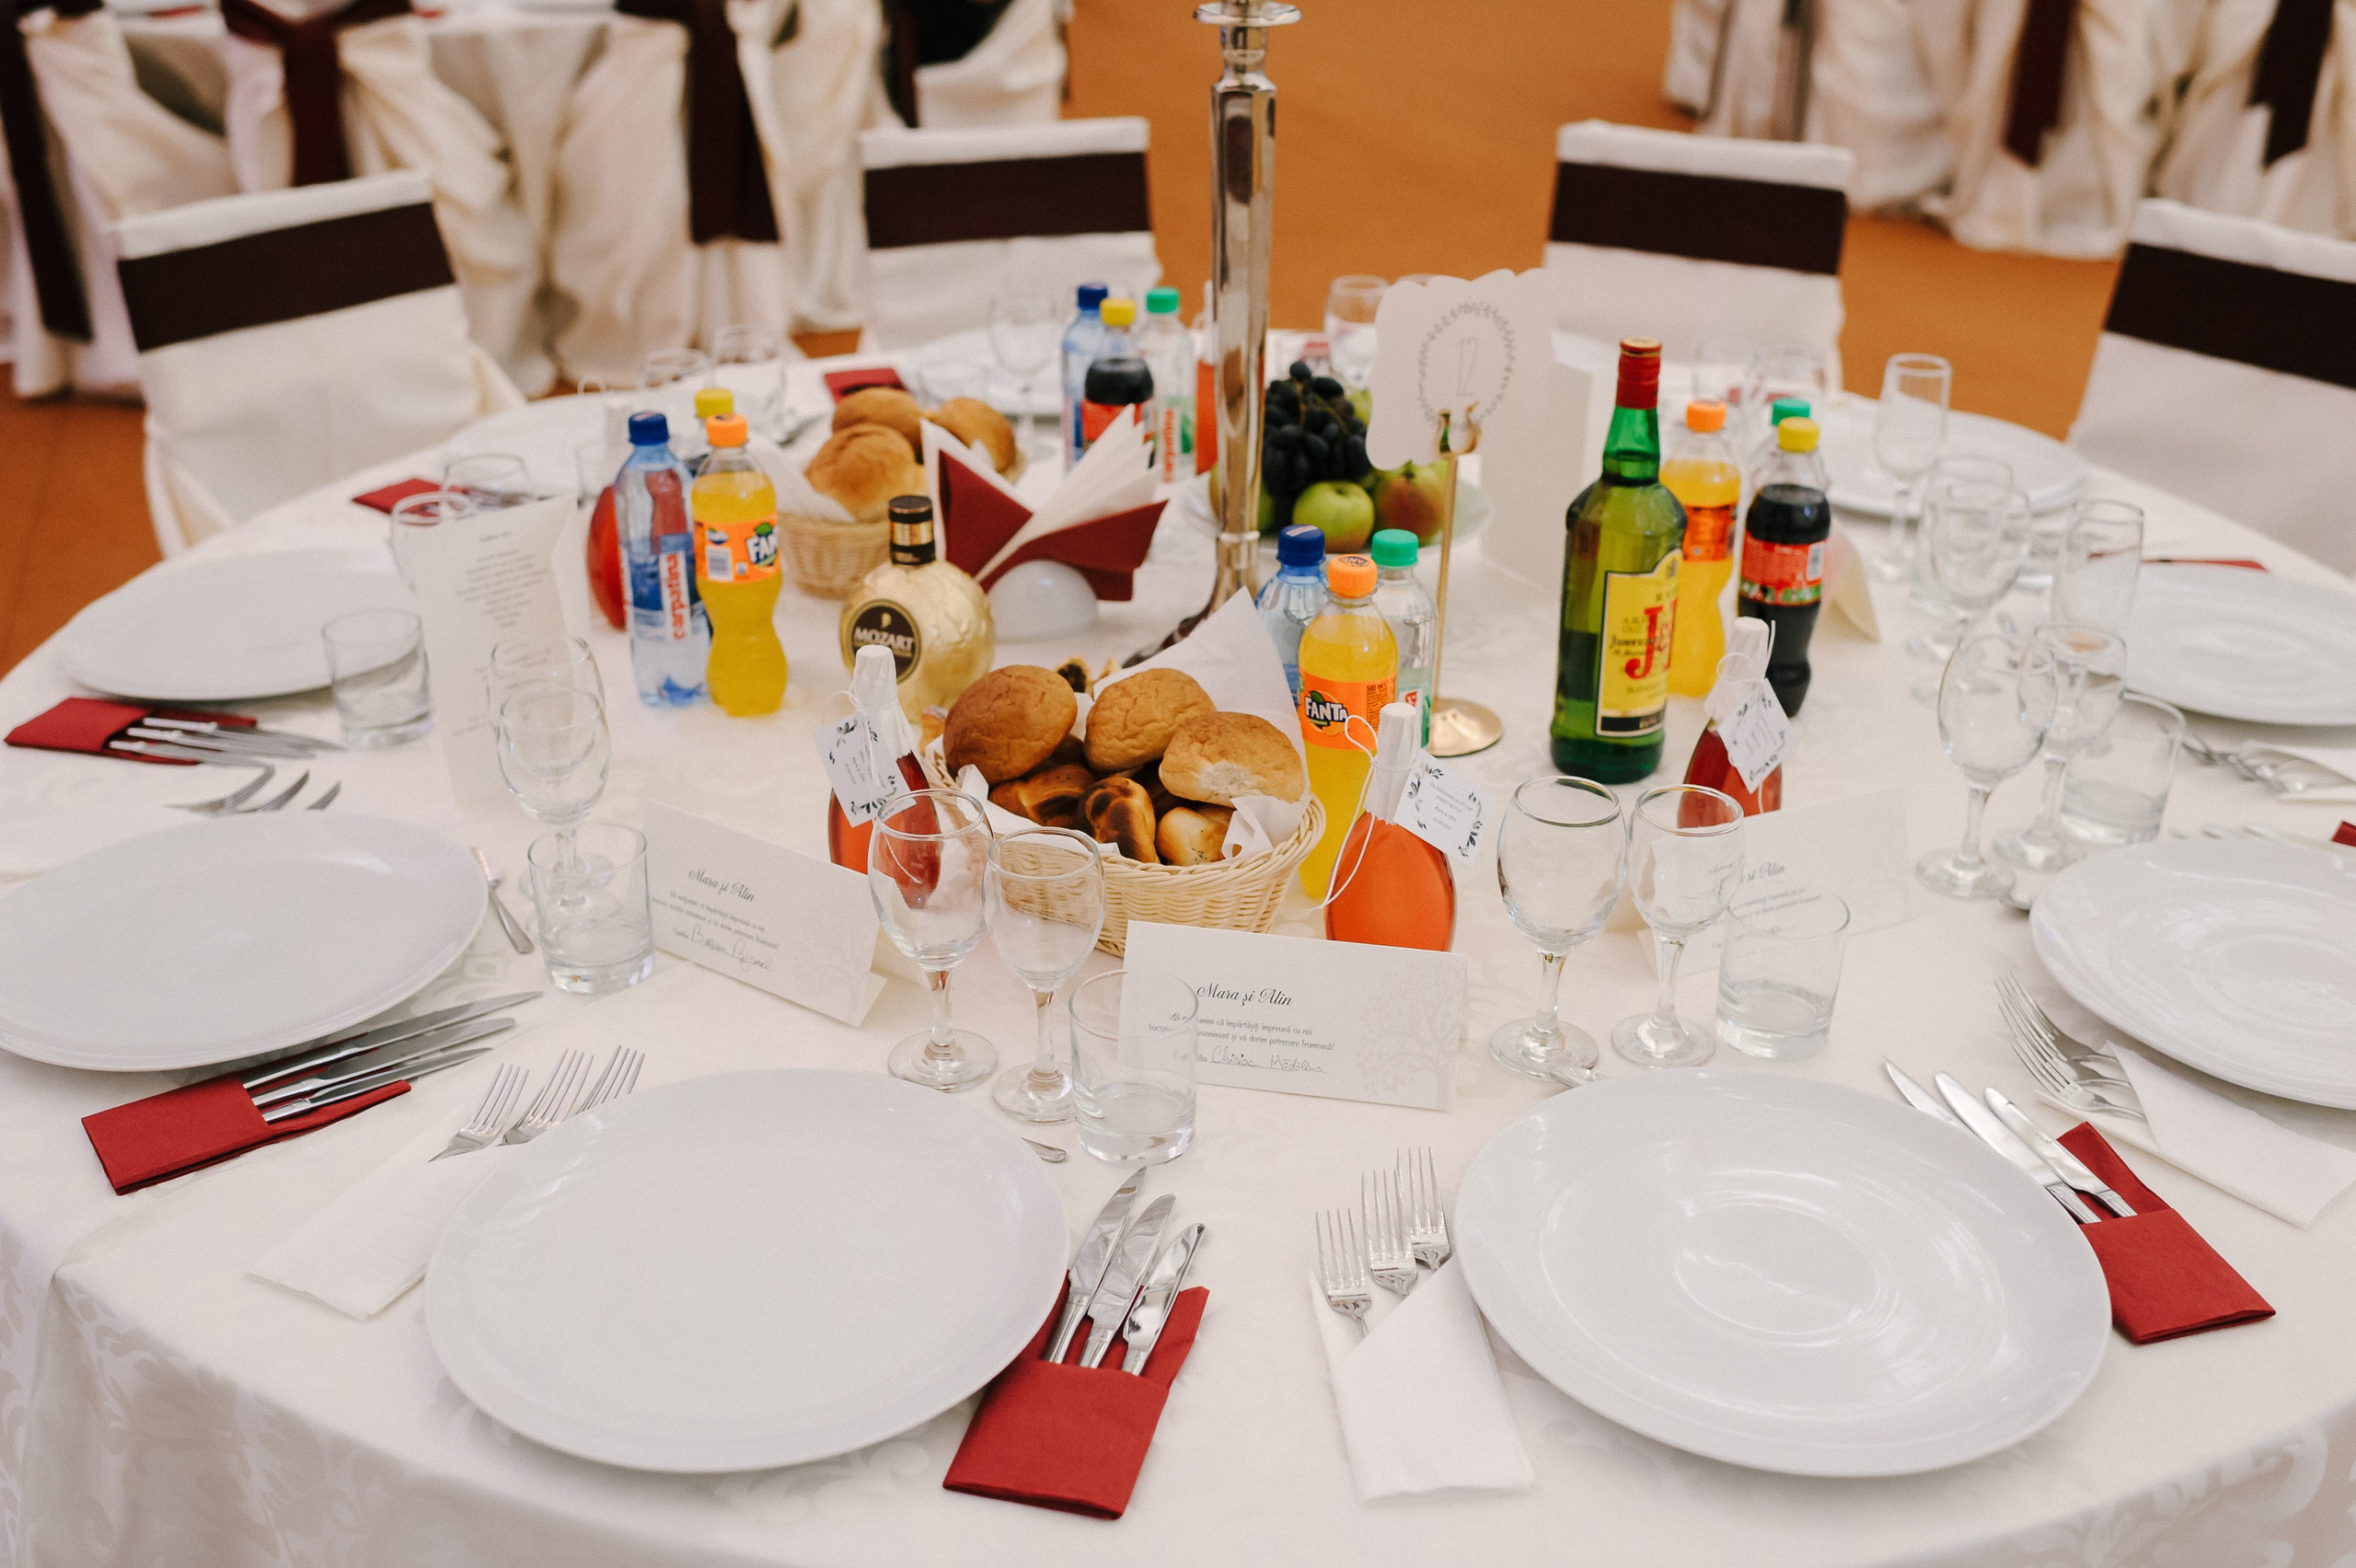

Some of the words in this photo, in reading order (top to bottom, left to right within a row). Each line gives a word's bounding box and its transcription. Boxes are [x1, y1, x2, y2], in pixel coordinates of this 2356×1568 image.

[854, 626, 914, 651] MOZART
[1305, 697, 1348, 722] FANTA
[1196, 983, 1240, 1001] Mara
[1258, 988, 1293, 1006] Alin
